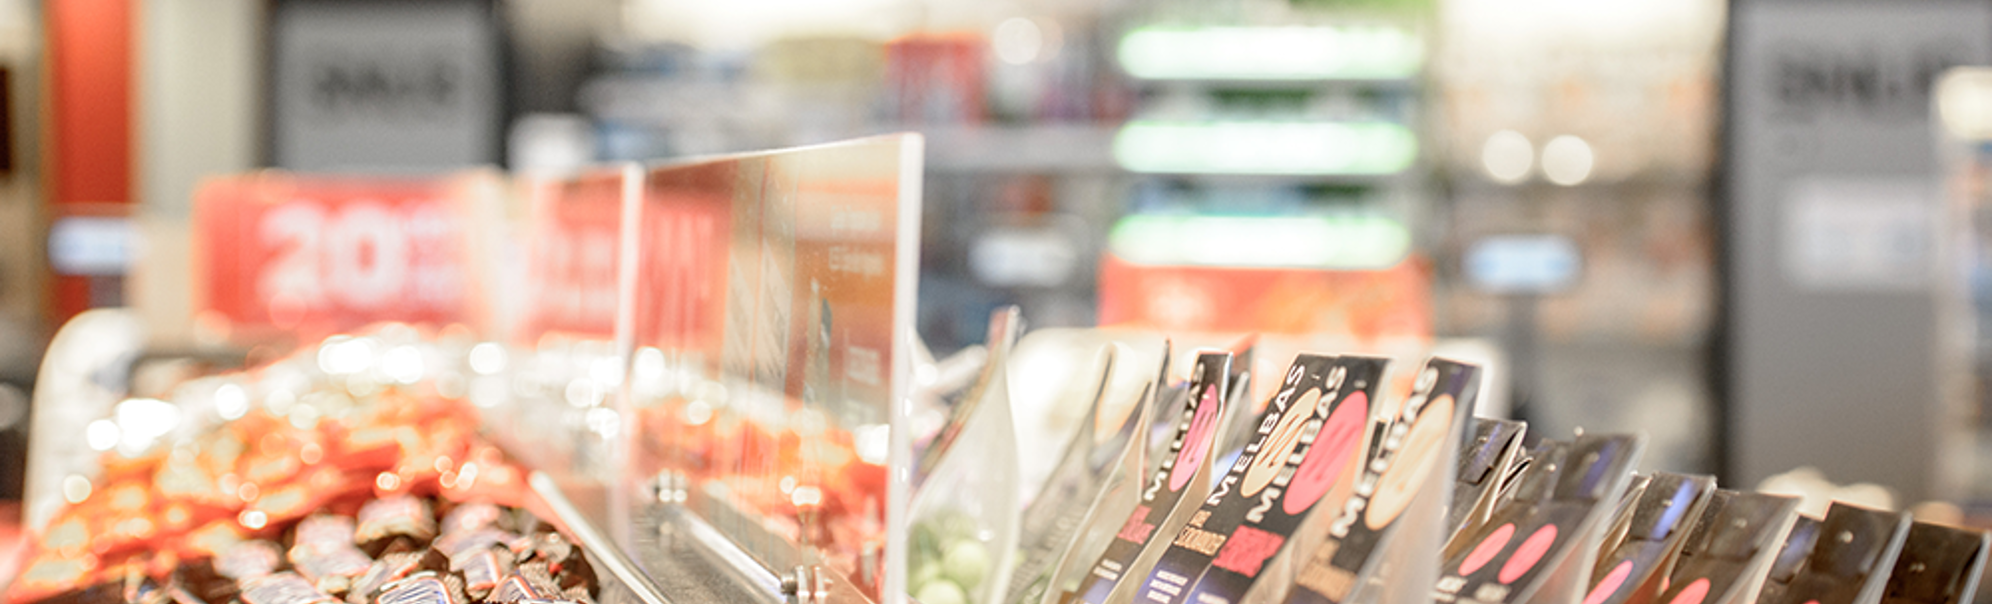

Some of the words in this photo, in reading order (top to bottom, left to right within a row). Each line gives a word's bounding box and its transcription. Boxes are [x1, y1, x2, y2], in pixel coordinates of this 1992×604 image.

[258, 201, 404, 306] 20
[1206, 364, 1305, 506] MELBAS
[1246, 365, 1347, 524] MELBAS
